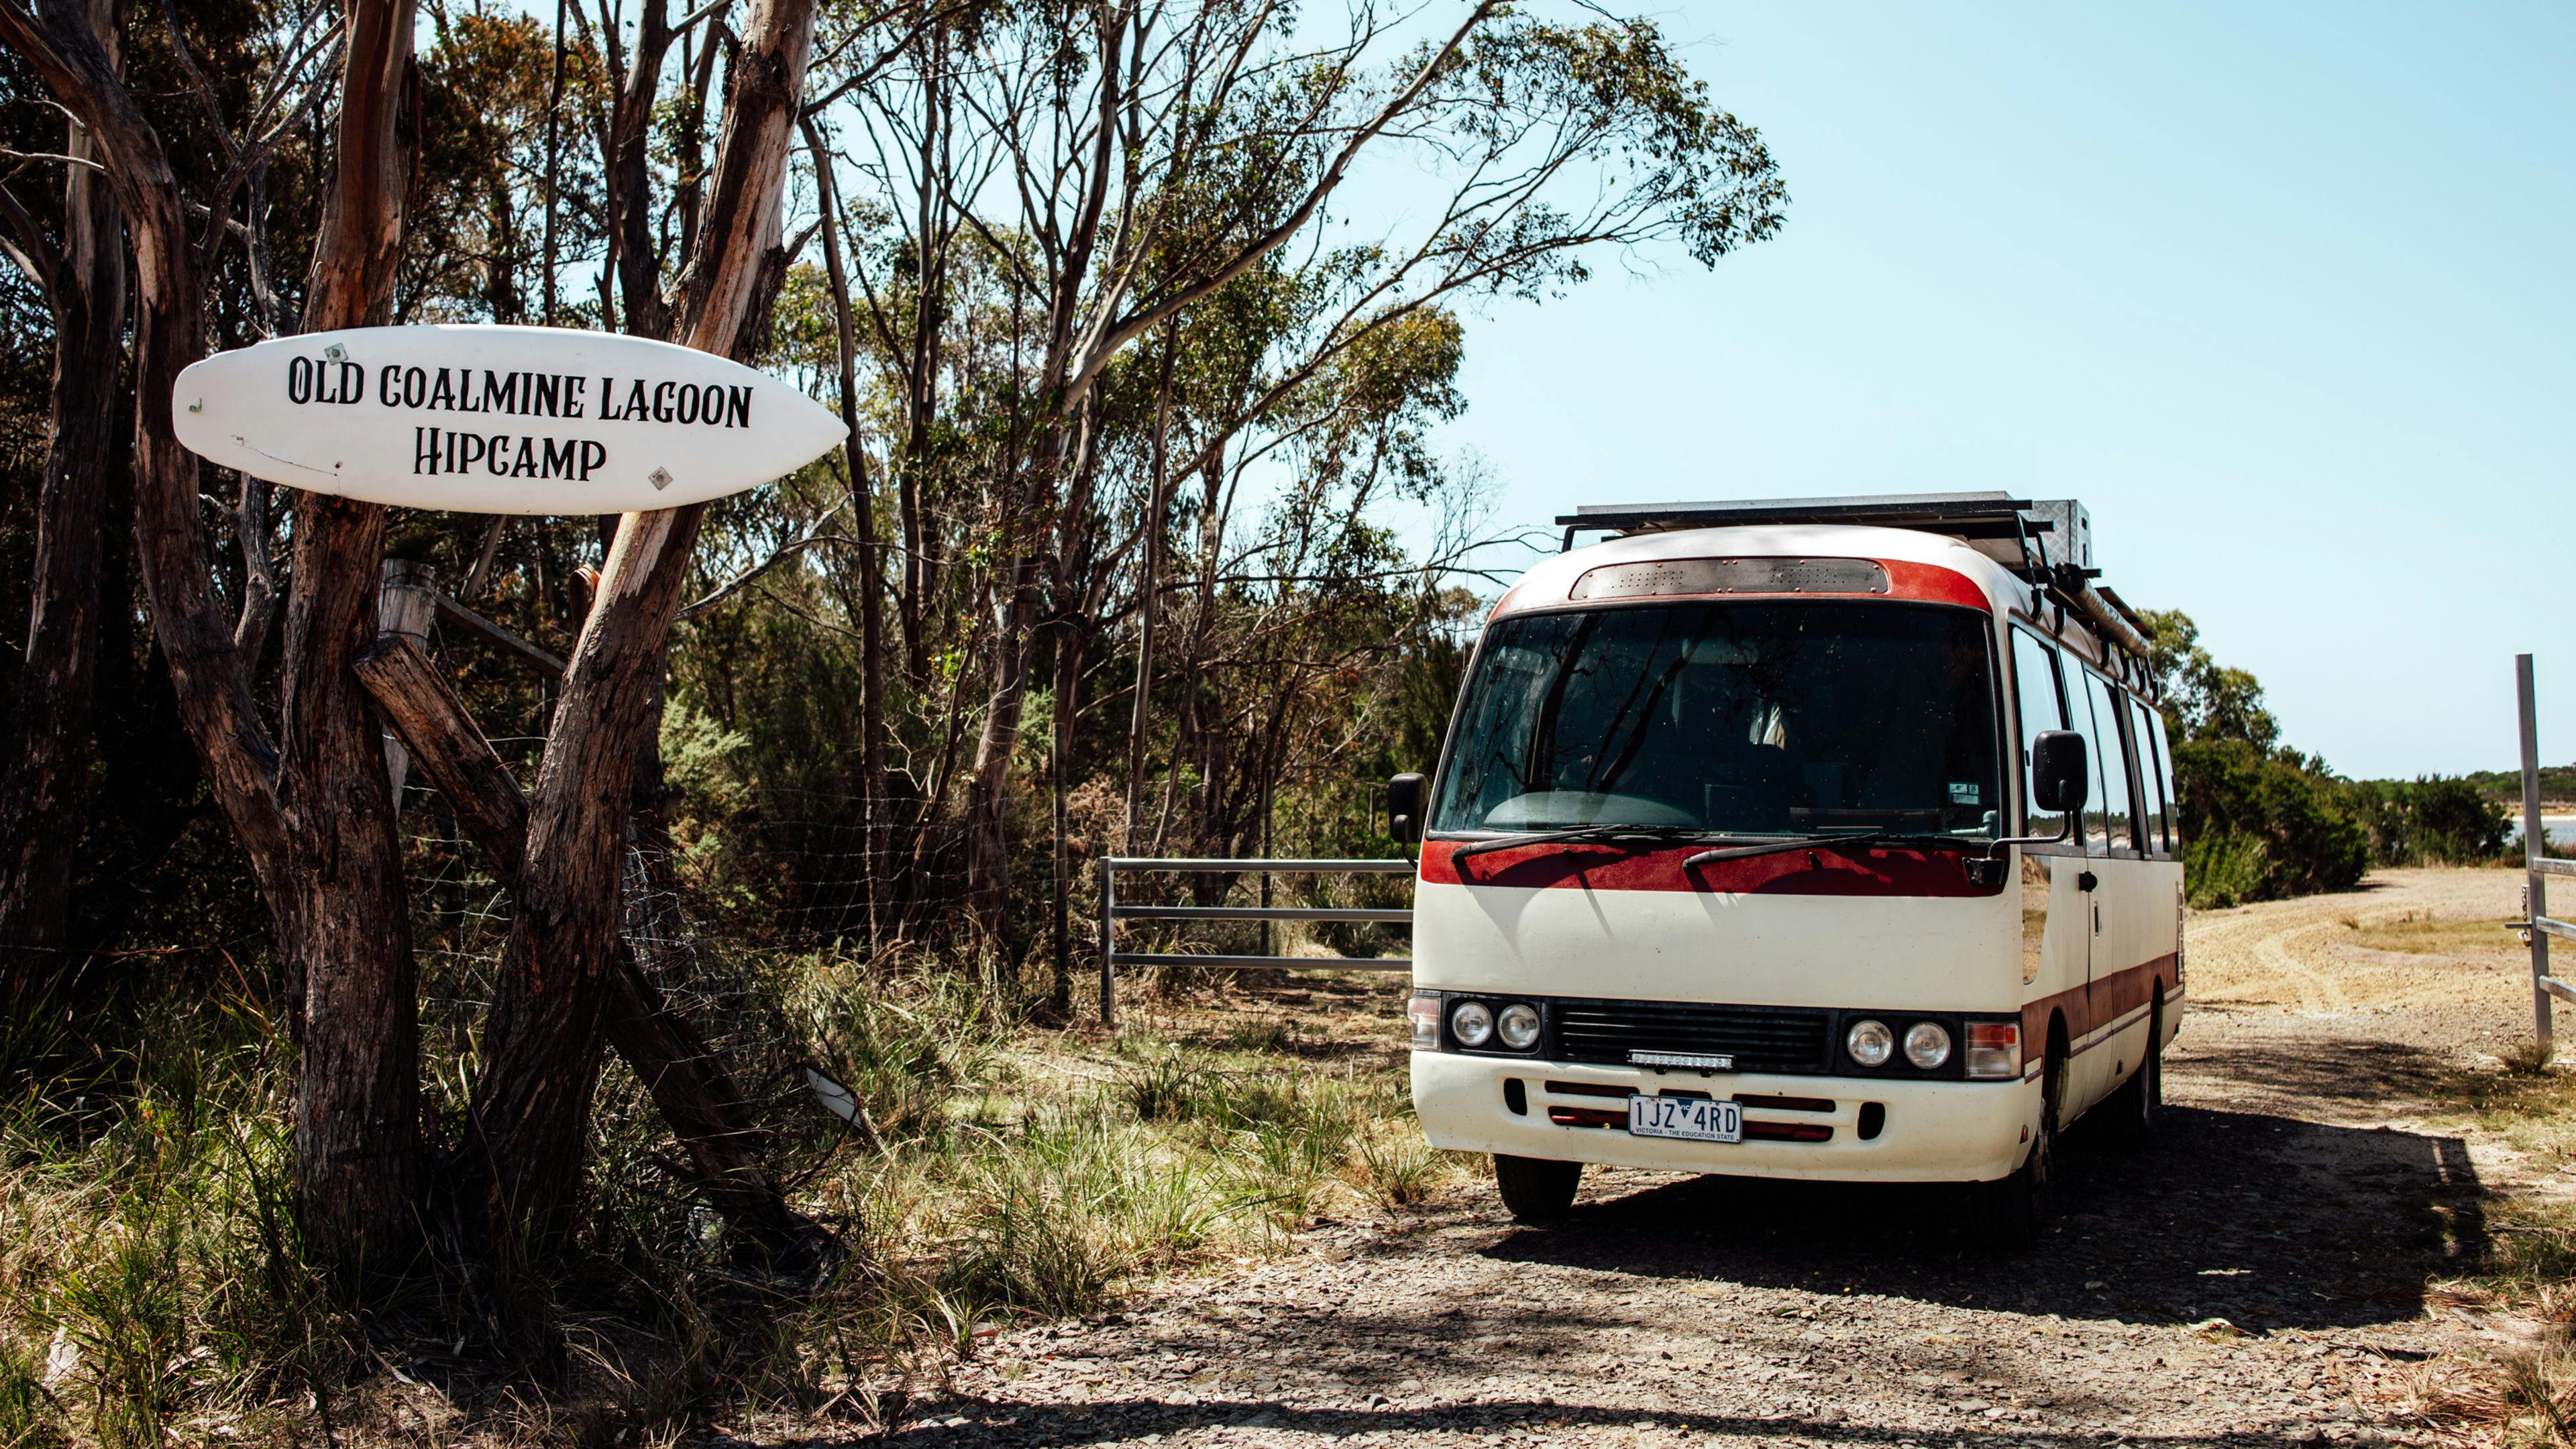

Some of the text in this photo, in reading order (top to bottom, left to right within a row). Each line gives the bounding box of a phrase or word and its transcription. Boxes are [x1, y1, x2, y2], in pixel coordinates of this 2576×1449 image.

[288, 356, 754, 429] OLD COALMINE LAGOON
[413, 427, 606, 482] HIPCAMP
[1635, 1127, 1663, 1135] VICTORIA
[1682, 1131, 1715, 1139] EDUCATION
[1636, 1102, 1737, 1133] 1JZ 4RD
